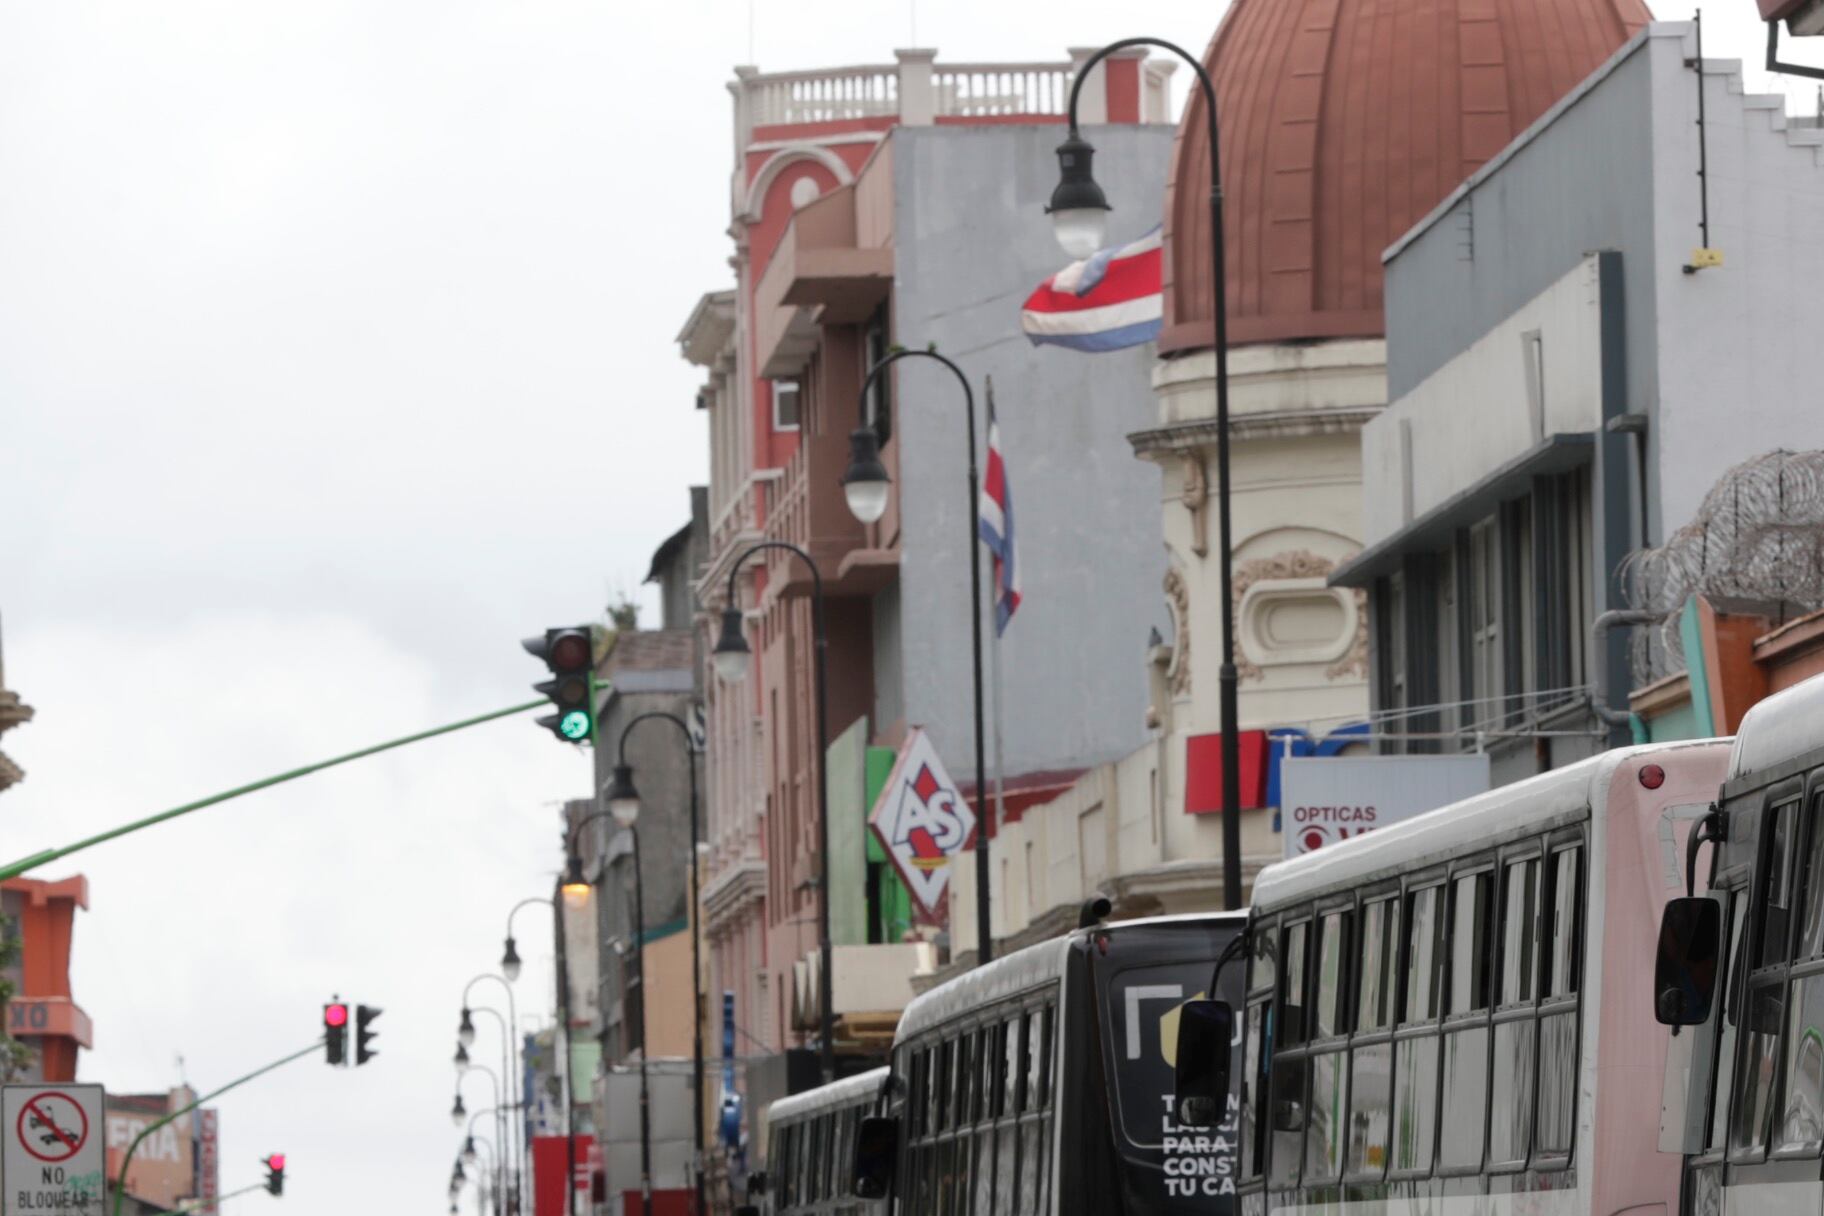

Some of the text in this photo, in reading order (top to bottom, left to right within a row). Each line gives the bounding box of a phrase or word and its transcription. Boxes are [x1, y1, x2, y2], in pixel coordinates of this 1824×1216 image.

[893, 777, 965, 851] AS
[1294, 805, 1377, 823] OPTICAS
[1163, 1135, 1230, 1154] PARA
[42, 1166, 65, 1185] NO
[1164, 1178, 1197, 1197] TU
